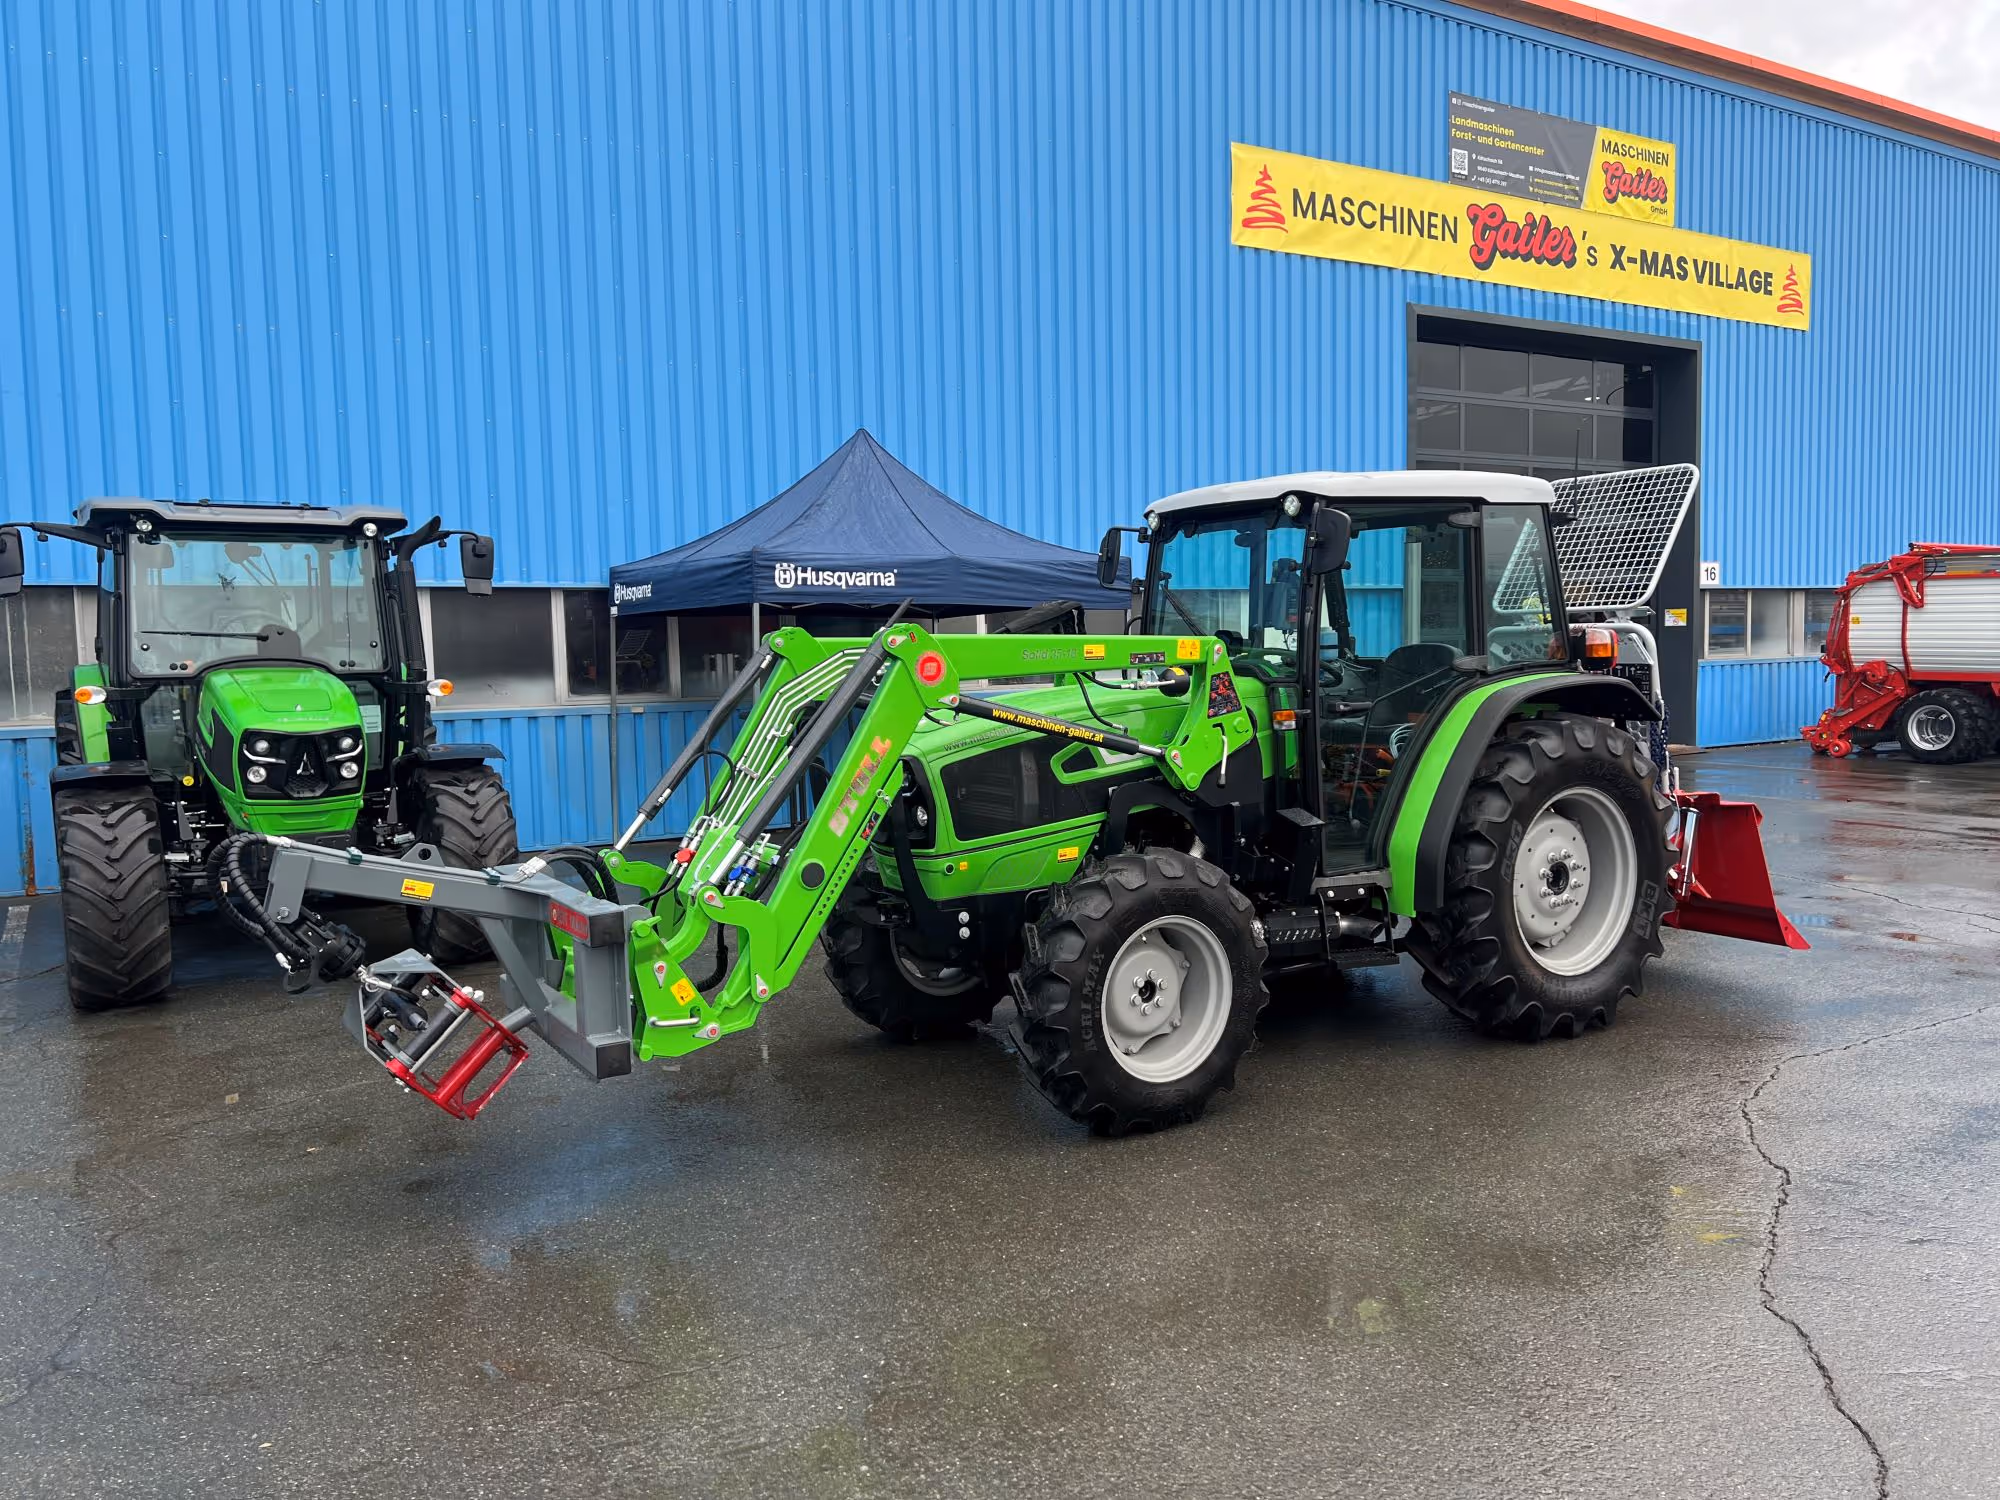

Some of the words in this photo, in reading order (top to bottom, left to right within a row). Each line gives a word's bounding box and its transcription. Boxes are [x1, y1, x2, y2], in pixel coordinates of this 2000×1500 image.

[1451, 114, 1515, 136] Landmaschinen
[1451, 128, 1476, 141] Forst-
[1477, 135, 1493, 146] und
[1494, 138, 1545, 156] Gartencenter
[1601, 138, 1670, 167] MASCHINEN
[1601, 161, 1668, 204] Gailer
[1650, 205, 1668, 215] GmbH
[1292, 188, 1458, 244] MASCHINEN
[1609, 243, 1689, 282] X-MAS
[1692, 258, 1773, 296] VILLAGE
[796, 566, 896, 589] Husqvarna
[1704, 566, 1717, 581] 16
[620, 582, 652, 602] Husqvarna
[991, 708, 1104, 743] www.maschinen-gailer.at
